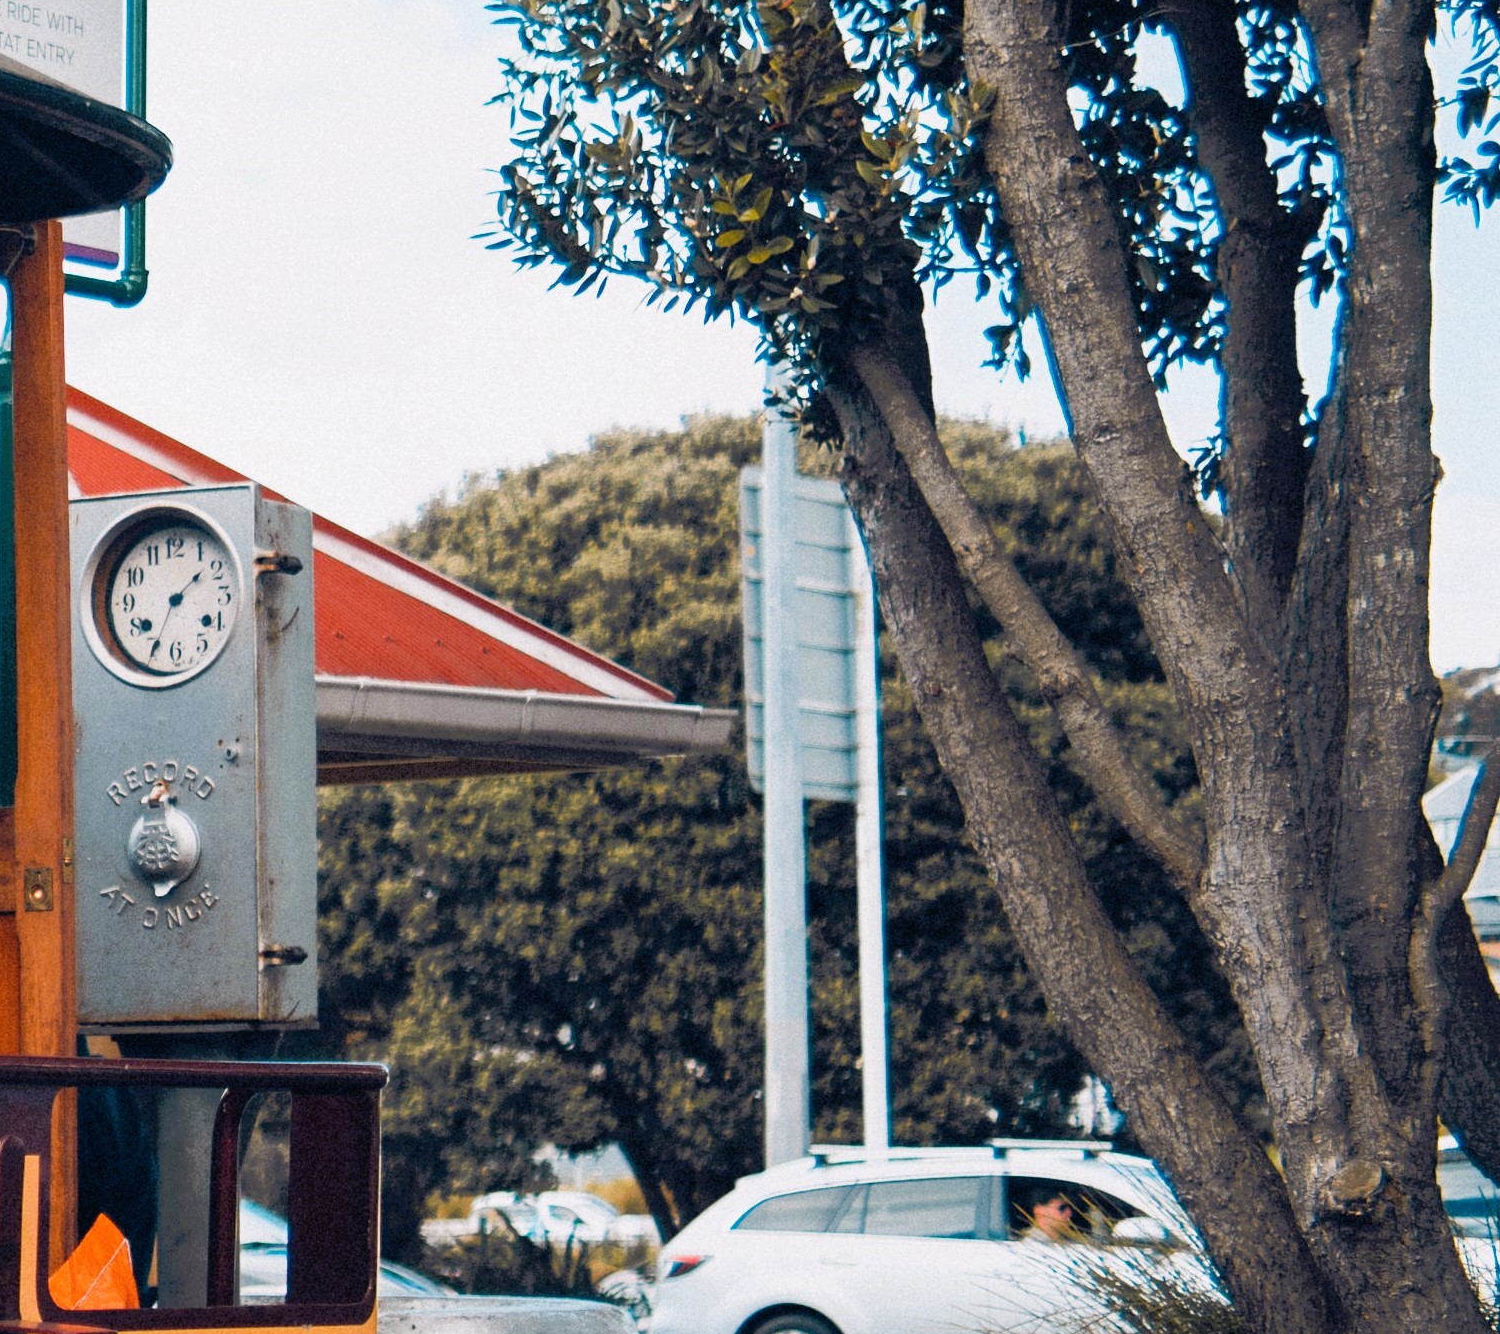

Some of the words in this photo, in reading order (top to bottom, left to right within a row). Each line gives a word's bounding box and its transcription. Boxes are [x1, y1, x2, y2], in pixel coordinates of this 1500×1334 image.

[7, 1, 41, 27] RIDE
[47, 10, 84, 37] WITH
[27, 38, 75, 66] ENTRY
[147, 545, 159, 566] 11
[166, 538, 184, 559] 12
[197, 541, 203, 562] 1
[127, 566, 144, 588] 10
[210, 560, 224, 580] 2
[123, 593, 135, 613] 9
[218, 585, 231, 606] 3
[170, 639, 182, 661] 6
[197, 633, 208, 653] 5
[106, 760, 215, 806] RECORD
[100, 886, 135, 915] AT
[143, 883, 220, 929] ONCE
